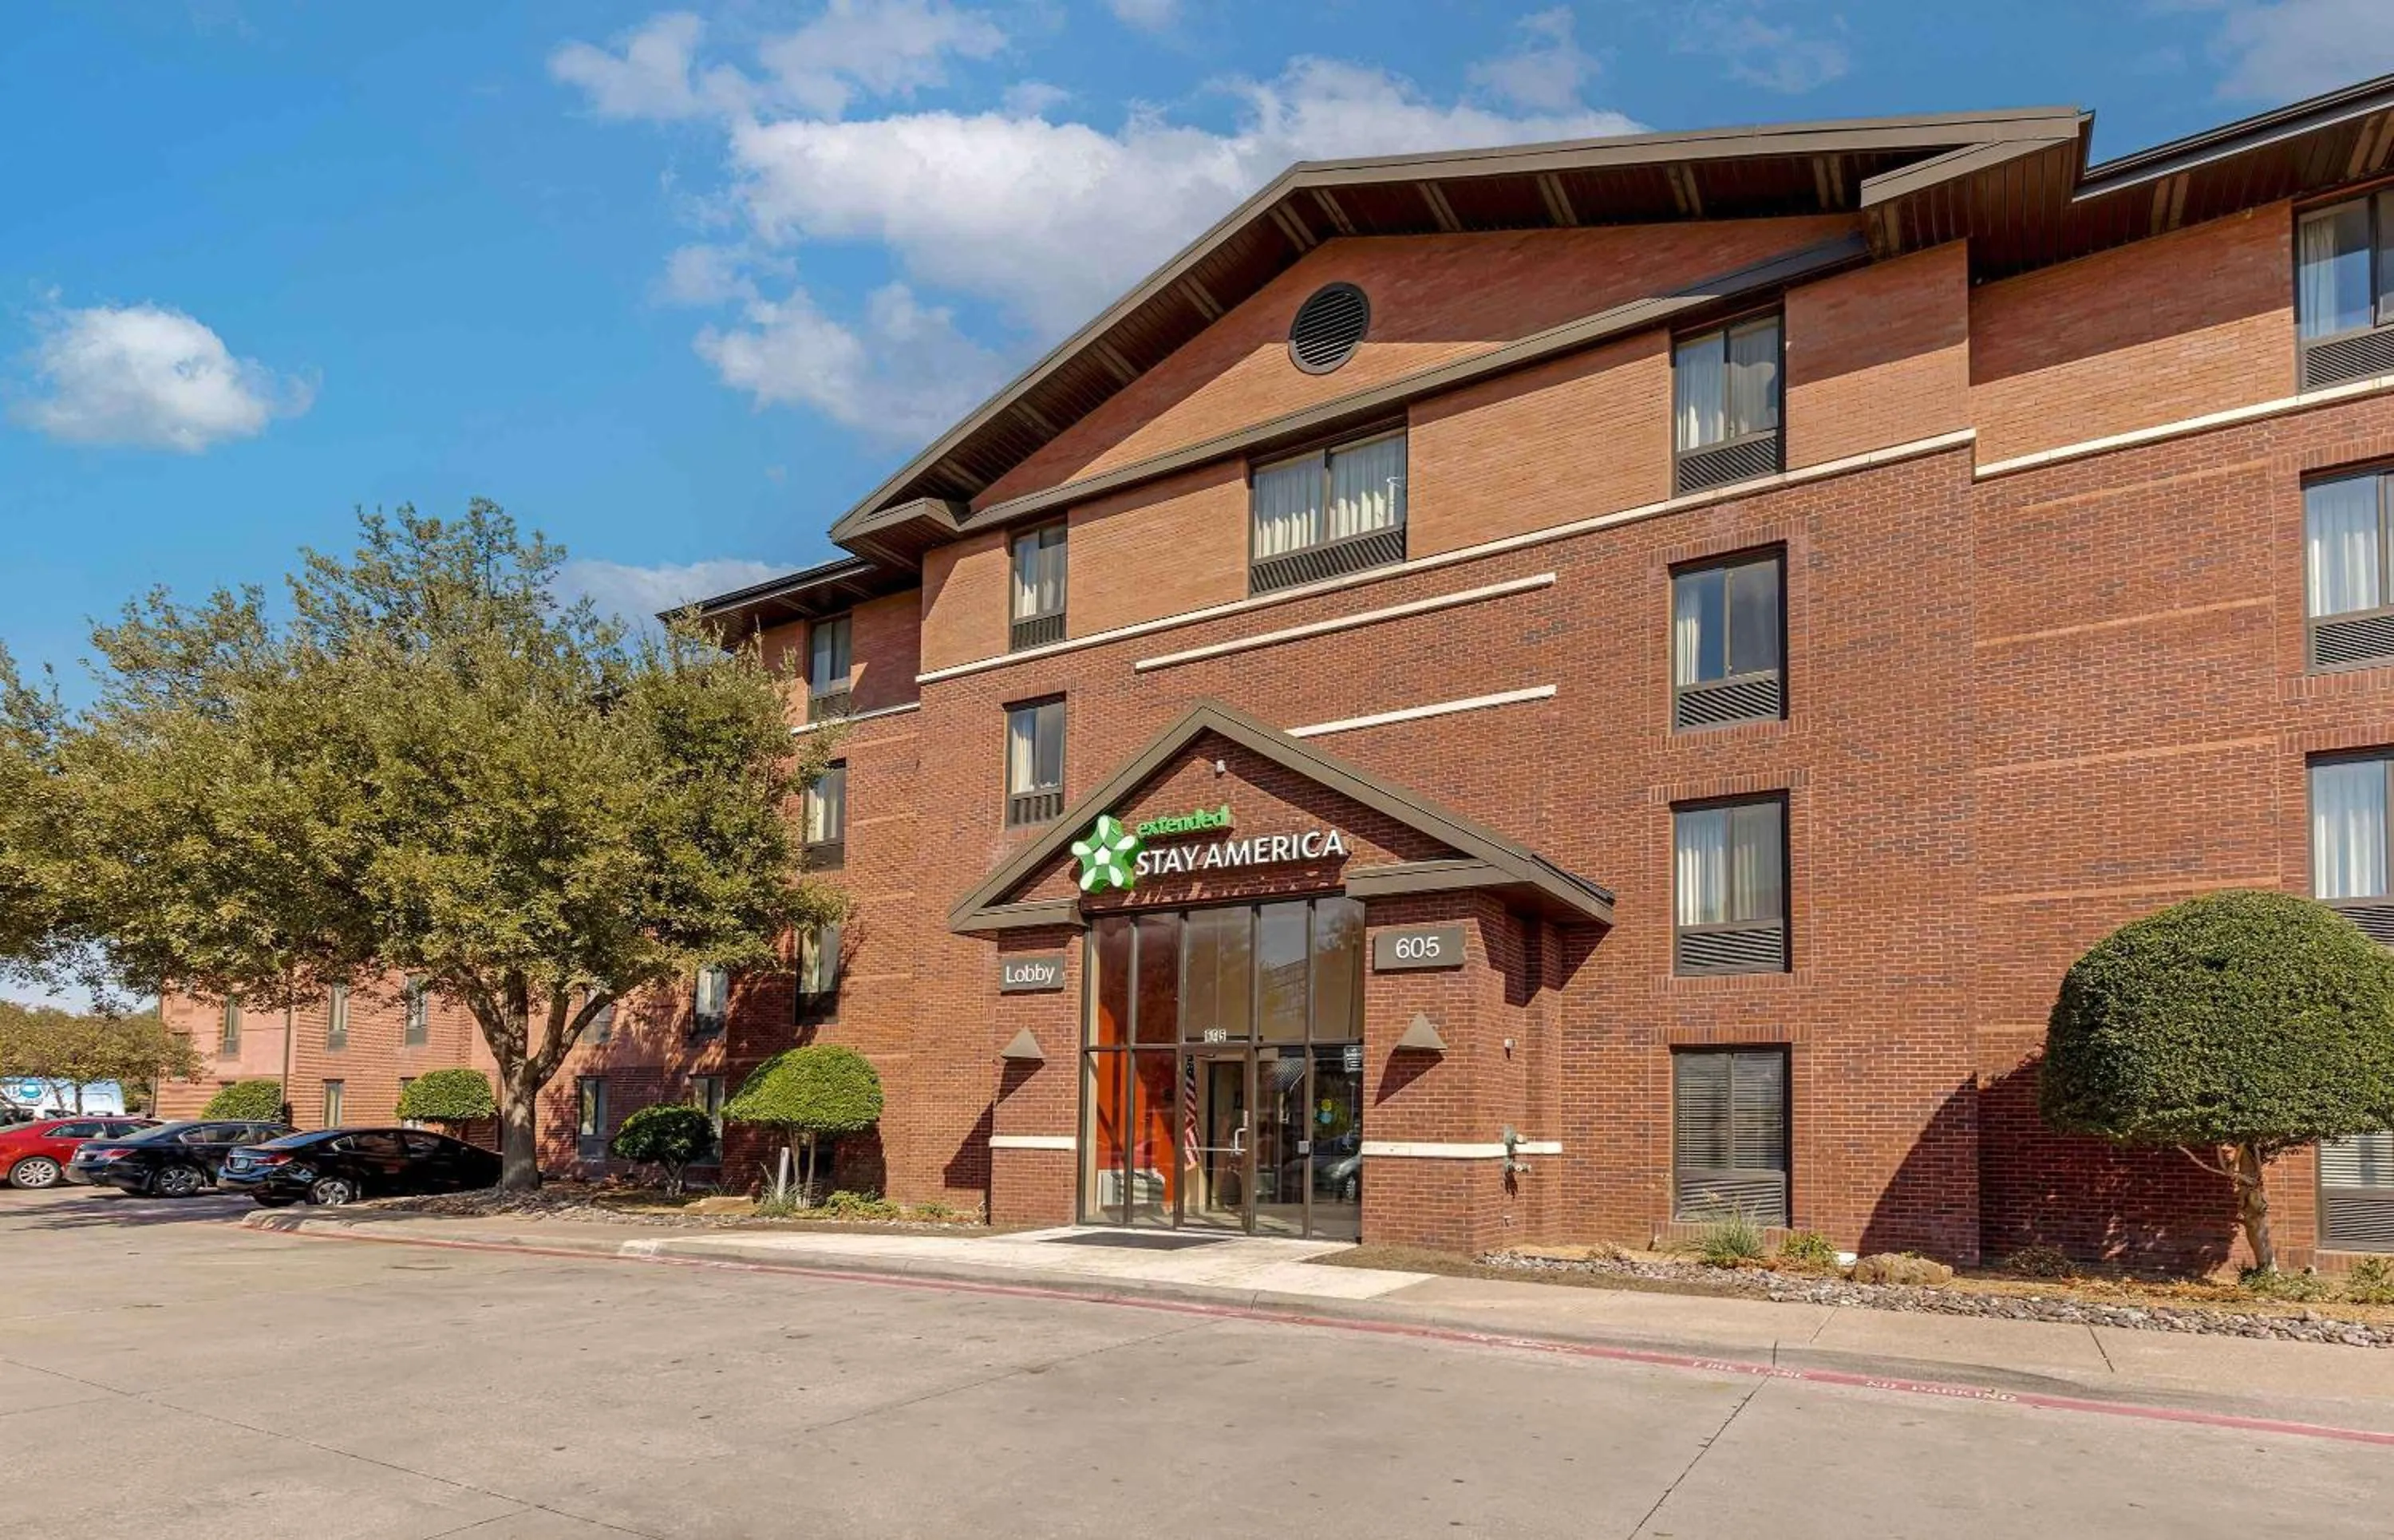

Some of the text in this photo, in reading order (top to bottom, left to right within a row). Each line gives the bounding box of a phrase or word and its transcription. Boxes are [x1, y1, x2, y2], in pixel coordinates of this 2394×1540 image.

[1136, 805, 1231, 836] extended
[1136, 829, 1345, 876] STAY AMERICA
[1396, 936, 1440, 958] 605
[1006, 963, 1056, 985] Lobby
